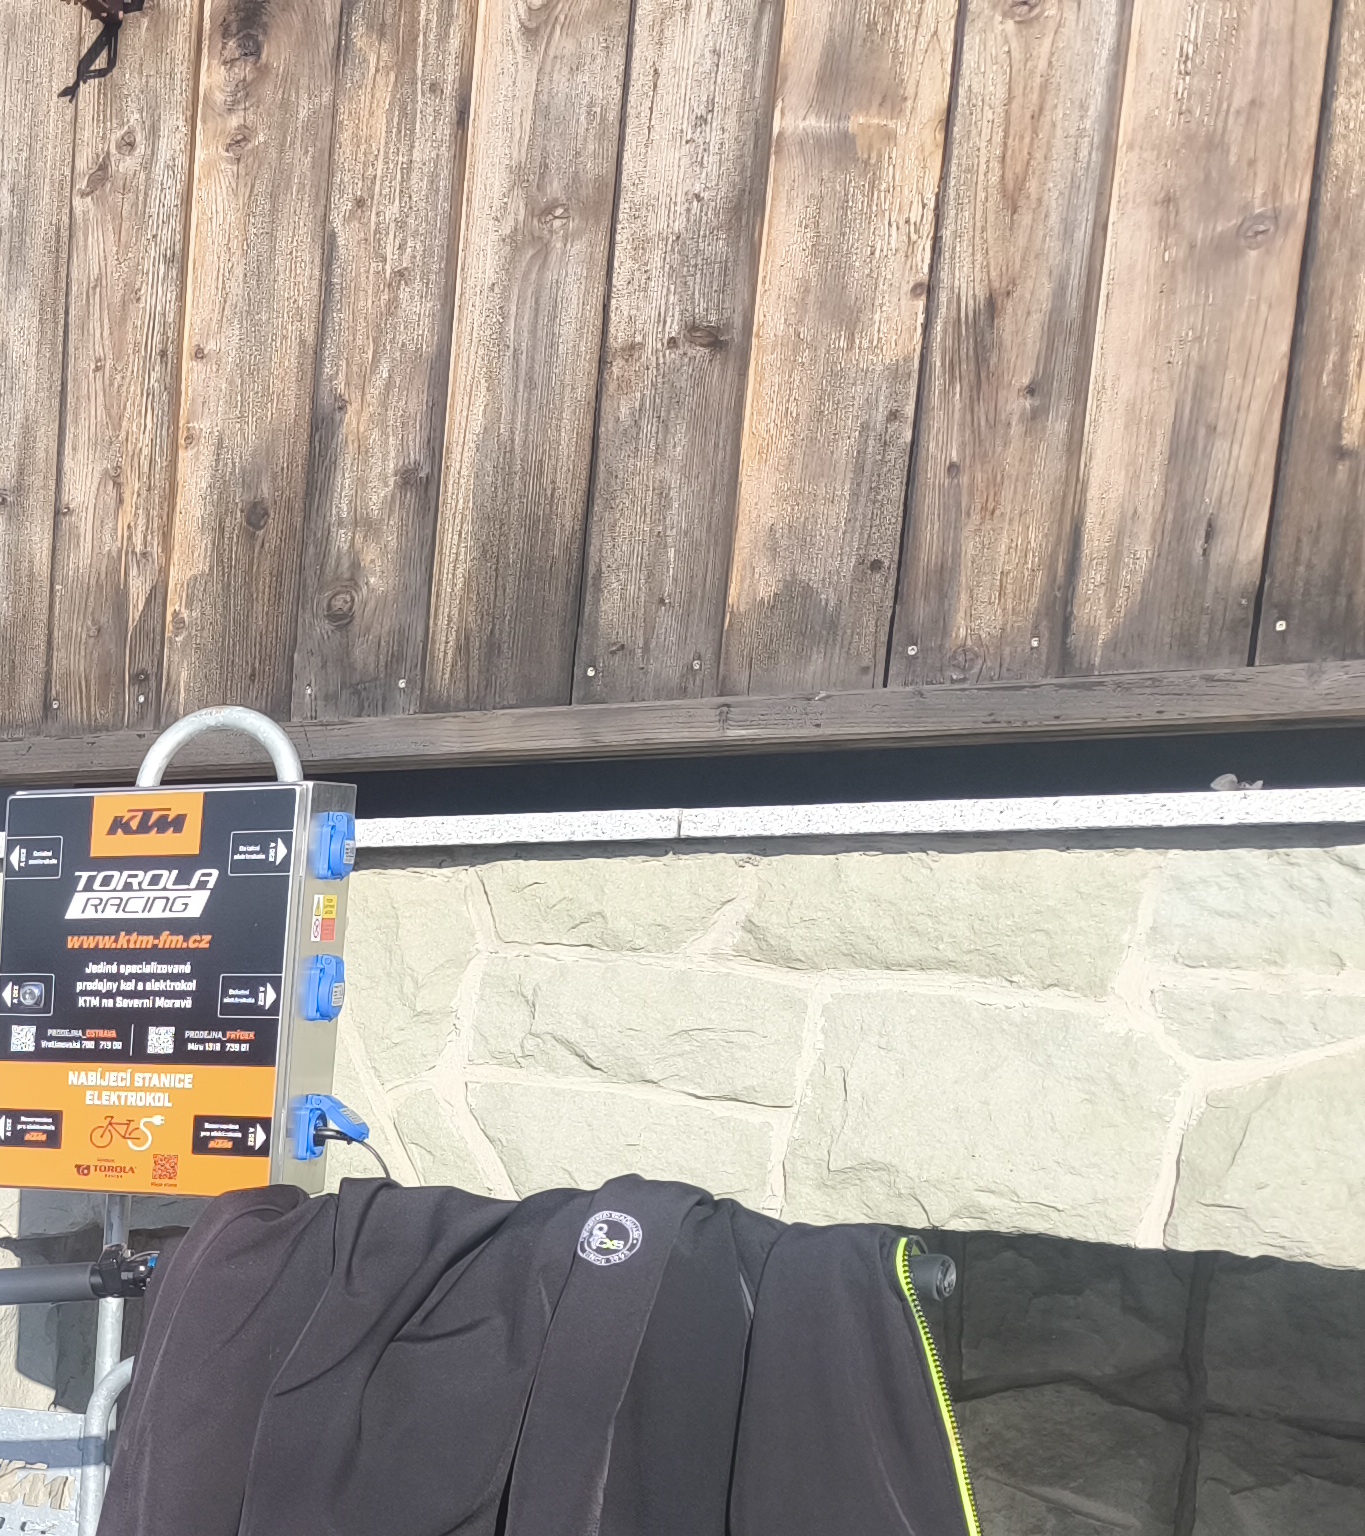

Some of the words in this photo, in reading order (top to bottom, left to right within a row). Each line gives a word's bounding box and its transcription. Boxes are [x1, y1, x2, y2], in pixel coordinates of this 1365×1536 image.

[105, 807, 188, 836] KTM
[73, 868, 219, 892] TOROLA
[82, 896, 190, 914] RACING
[67, 931, 212, 949] www.ktm-fm.cz
[68, 1068, 132, 1087] NABÍJECÍ
[134, 1073, 194, 1089] STANICE
[85, 1090, 173, 1107] ELEKTROKOL
[92, 1164, 137, 1174] TOROLA
